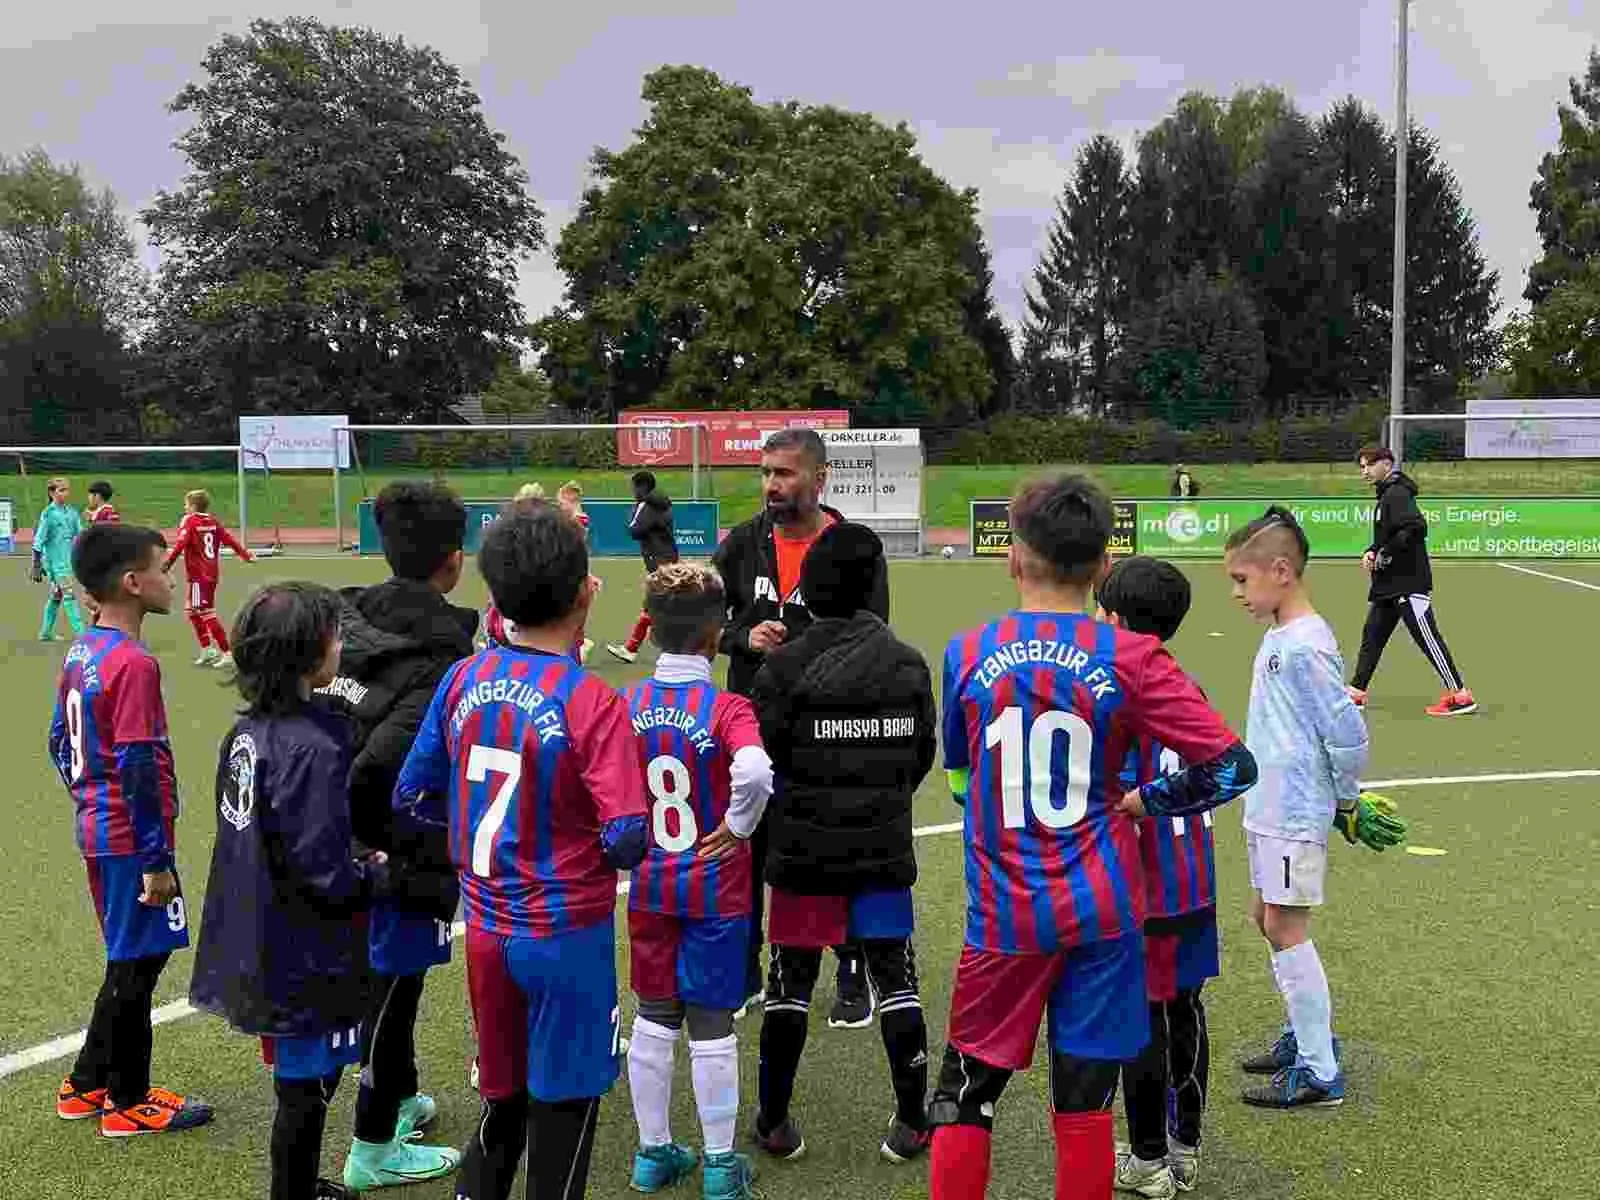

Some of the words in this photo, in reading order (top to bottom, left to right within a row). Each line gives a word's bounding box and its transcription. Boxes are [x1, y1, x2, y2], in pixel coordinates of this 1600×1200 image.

[1311, 505, 1348, 522] sind
[203, 532, 215, 559] 8
[1085, 667, 1116, 700] FK
[66, 687, 84, 785] 9
[534, 709, 564, 744] FK
[689, 727, 715, 755] FK
[814, 718, 880, 739] LAMASYA
[985, 706, 1093, 829] 10
[466, 744, 522, 879] 7
[647, 754, 698, 852] 8
[1281, 855, 1291, 889] 1
[167, 896, 185, 931] 9
